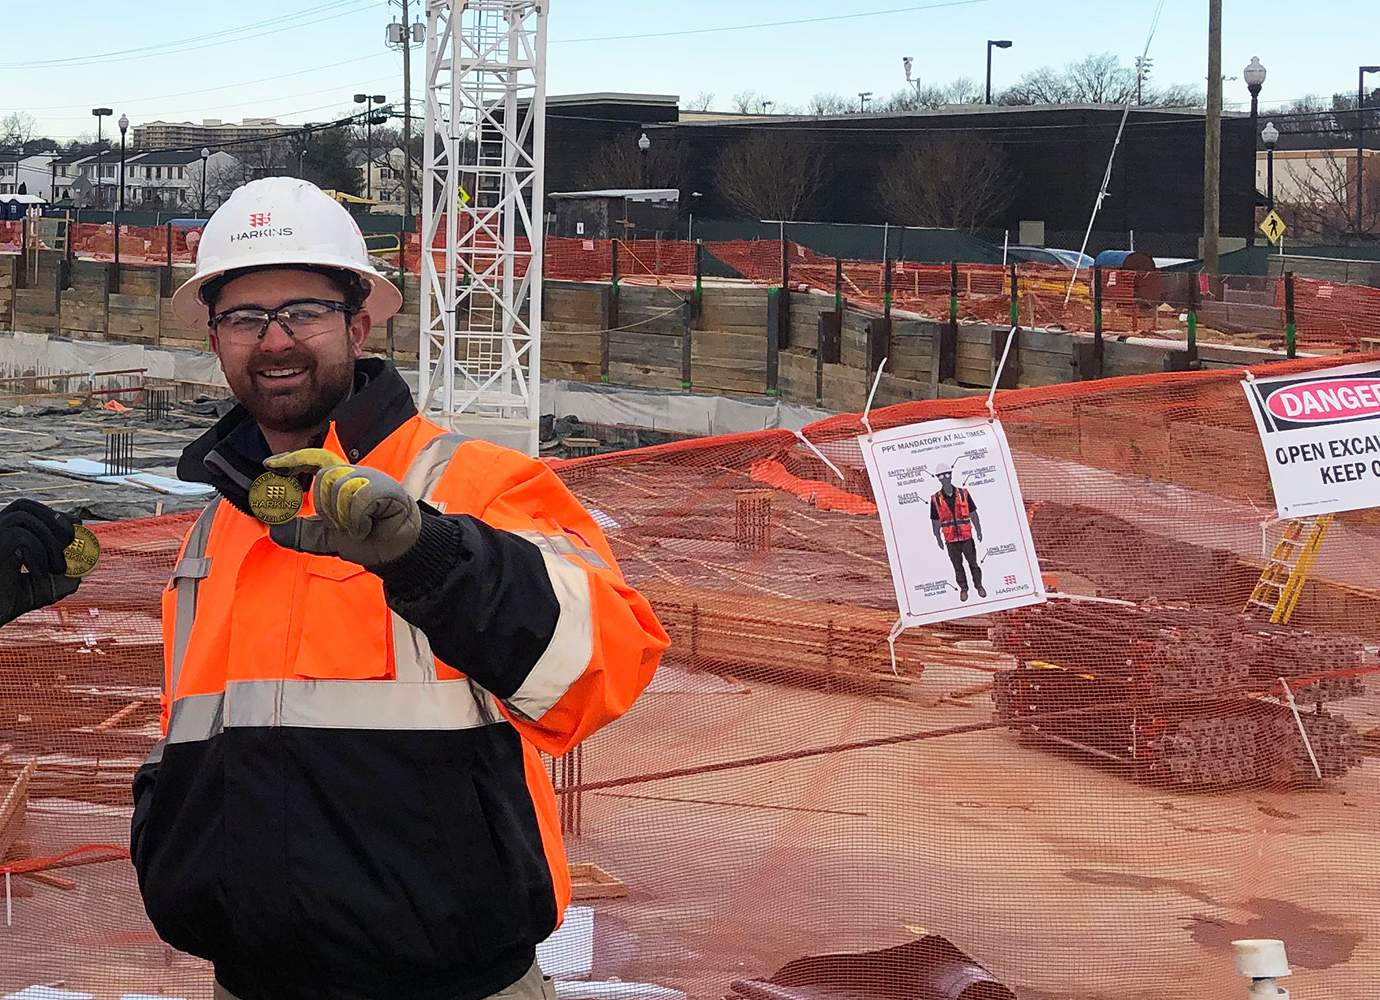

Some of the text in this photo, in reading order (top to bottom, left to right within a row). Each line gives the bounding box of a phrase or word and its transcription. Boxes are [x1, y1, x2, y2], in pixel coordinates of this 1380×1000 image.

[230, 227, 293, 242] HARKINS
[1279, 384, 1380, 417] DANGE
[881, 445, 896, 453] PPE
[897, 436, 942, 450] MANDATORY
[943, 435, 952, 443] AT
[953, 432, 965, 440] ALL
[965, 430, 986, 438] TIMES
[1275, 442, 1325, 465] OPEN
[1320, 462, 1367, 485] KEEP
[250, 500, 300, 509] HARKINS
[995, 584, 1030, 595] HARKINS
